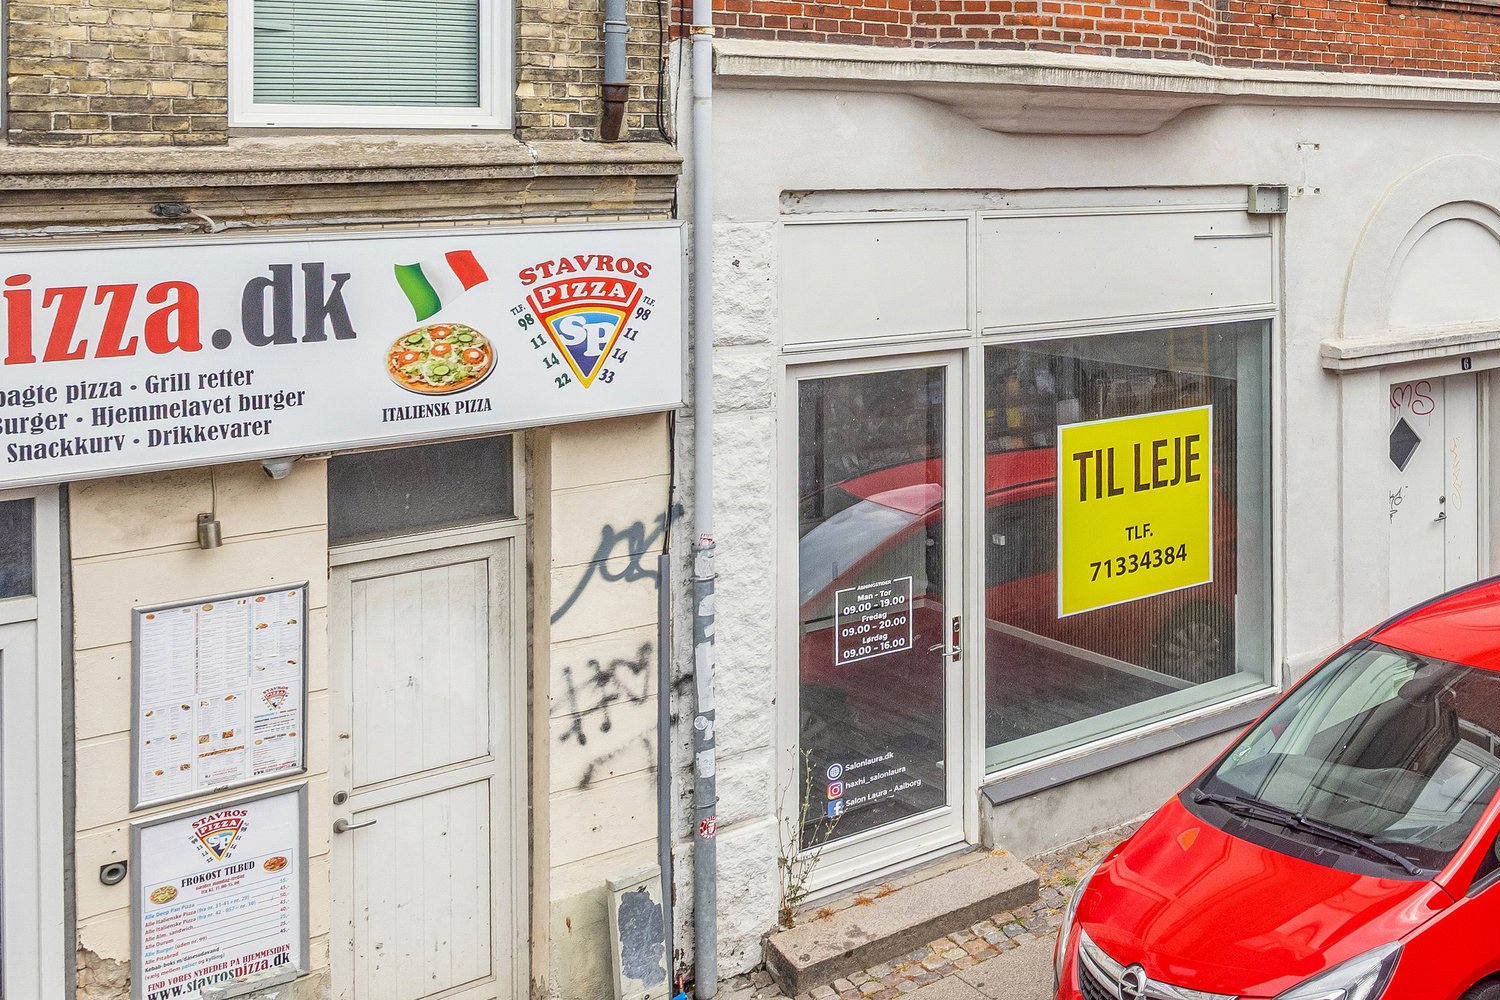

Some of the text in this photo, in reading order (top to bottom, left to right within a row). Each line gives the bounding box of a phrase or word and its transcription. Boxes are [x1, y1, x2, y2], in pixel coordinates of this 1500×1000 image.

[518, 254, 652, 286] STAVROS
[542, 281, 627, 303] PIZZA
[643, 295, 655, 306] TLF.
[3, 262, 357, 365] izza.dk
[510, 304, 526, 316] TLF.
[635, 307, 650, 321] 98
[518, 313, 535, 331] 98
[530, 334, 545, 349] 11
[559, 315, 616, 357] SP
[624, 328, 639, 341] 11
[543, 352, 559, 369] 14
[611, 348, 627, 363] 14
[554, 373, 571, 389] 22
[598, 369, 615, 383] 33
[66, 380, 122, 404] pizza
[145, 372, 190, 394] Grill
[198, 368, 254, 390] retter
[0, 389, 305, 435] urger Hjemmelavet burger
[382, 398, 492, 422] ITALIENSK PIZZA
[7, 418, 272, 463] Snackkurv Drikkevarer
[1073, 434, 1201, 502] TIL LEJE
[1125, 523, 1153, 541] TLF.
[1090, 544, 1187, 582] 71334384
[843, 602, 871, 615] 09.00
[880, 596, 905, 607] 19.00
[857, 593, 873, 602] Man
[842, 624, 870, 637] 09.00
[879, 616, 906, 629] 20.00
[861, 612, 888, 622] Fredag
[843, 646, 871, 658] 09.00
[880, 638, 905, 650] 16.00
[862, 633, 888, 644] Lørdag
[845, 752, 894, 771] Salonlaura.dk
[845, 796, 866, 807] Salon
[867, 789, 887, 800] Laura
[894, 779, 922, 793] Aalborg
[192, 809, 248, 829] STAVROS
[181, 861, 255, 888] FROKOST TILBUD
[147, 944, 290, 992] FIND VORES NYHEDER PÅ HJEMMESIDEN
